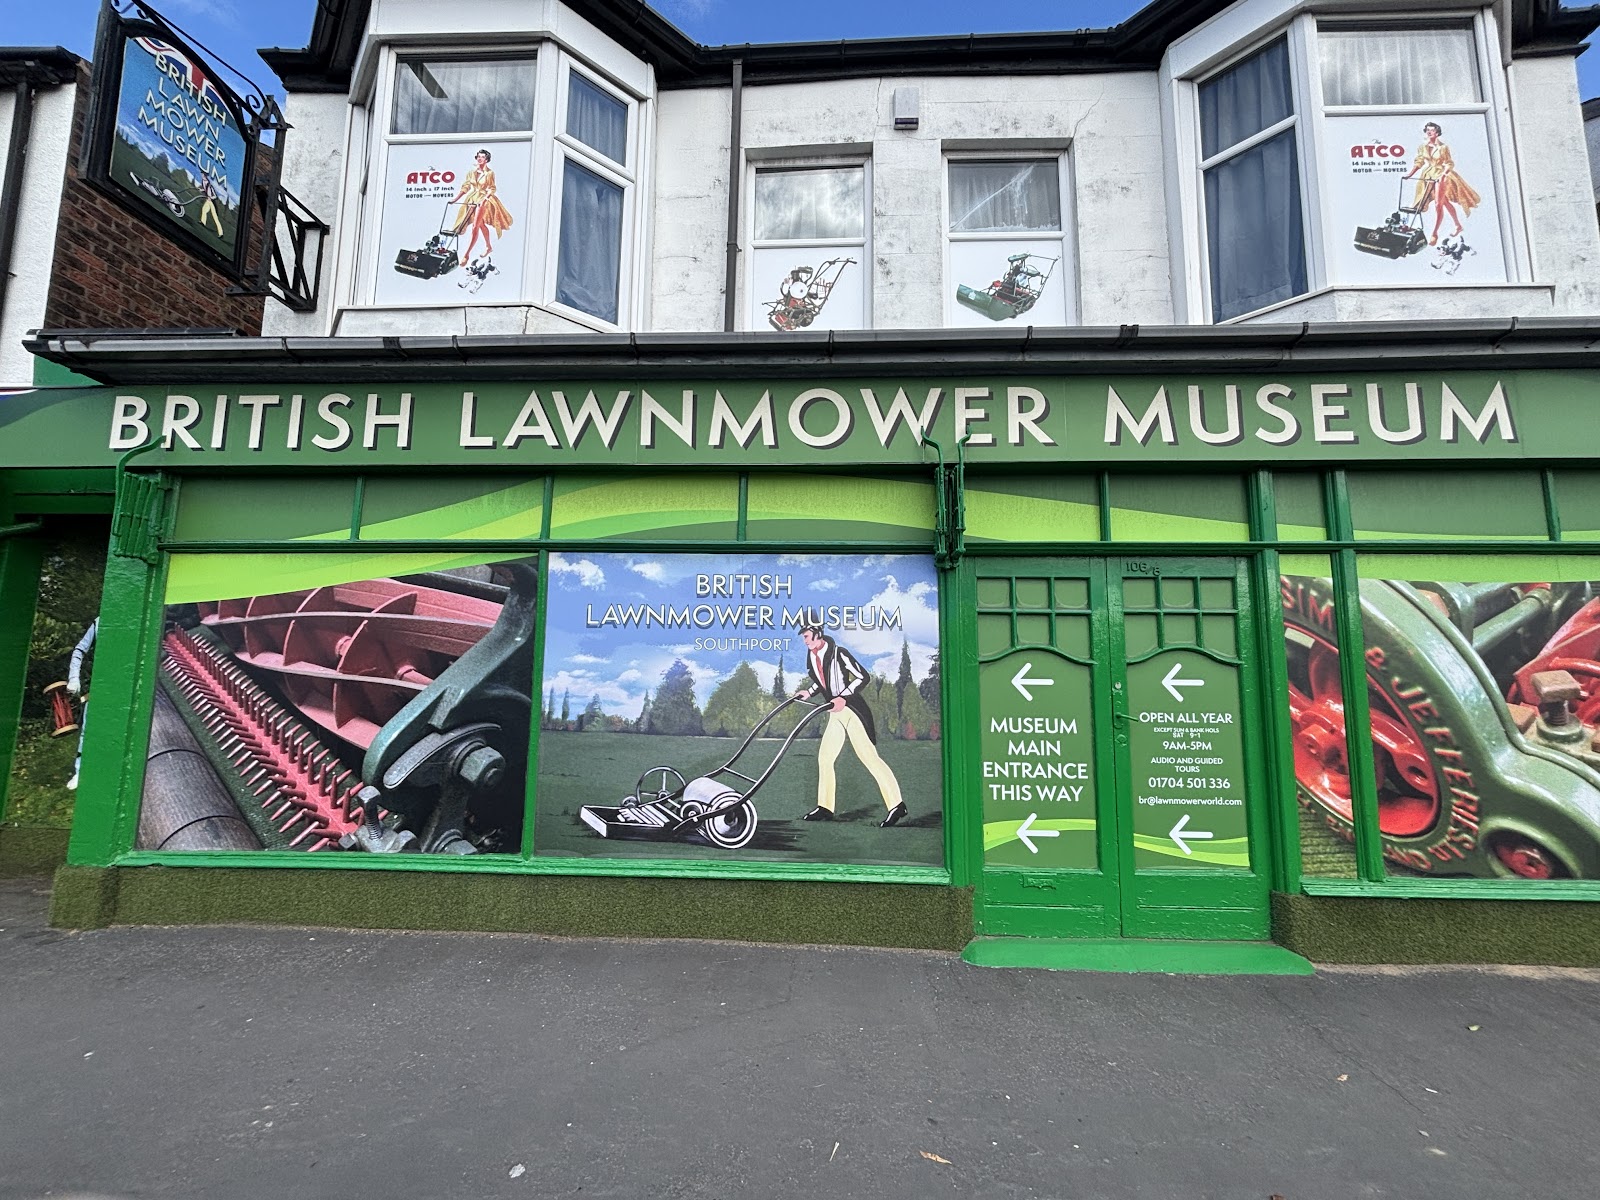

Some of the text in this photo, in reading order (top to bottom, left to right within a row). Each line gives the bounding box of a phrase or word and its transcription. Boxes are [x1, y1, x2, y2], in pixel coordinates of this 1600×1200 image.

[156, 52, 226, 126] BRITISH
[158, 76, 219, 141] LAWN
[146, 89, 226, 167] MOWER
[138, 105, 228, 189] MUSEUM
[1350, 144, 1405, 158] ATCO
[406, 171, 456, 184] ATCO
[108, 380, 1519, 451] BRITISH LAWNMOWER MUSEUM
[696, 573, 793, 598] BRITISH
[586, 603, 904, 631] LAWNMOWER MUSEUM
[694, 637, 792, 652] SOUTHPORT
[990, 717, 1078, 734] MUSEUM
[1139, 712, 1233, 724] OPEN ALL YEAR
[1008, 740, 1061, 756] MAIN
[1162, 740, 1212, 750] 9AM-5PM
[983, 762, 1089, 779] ENTRANCE
[1148, 777, 1231, 788] 01704 501 336
[989, 784, 1084, 802] THIS WAY
[1138, 796, 1242, 806] br@lawnmowerworld.com
